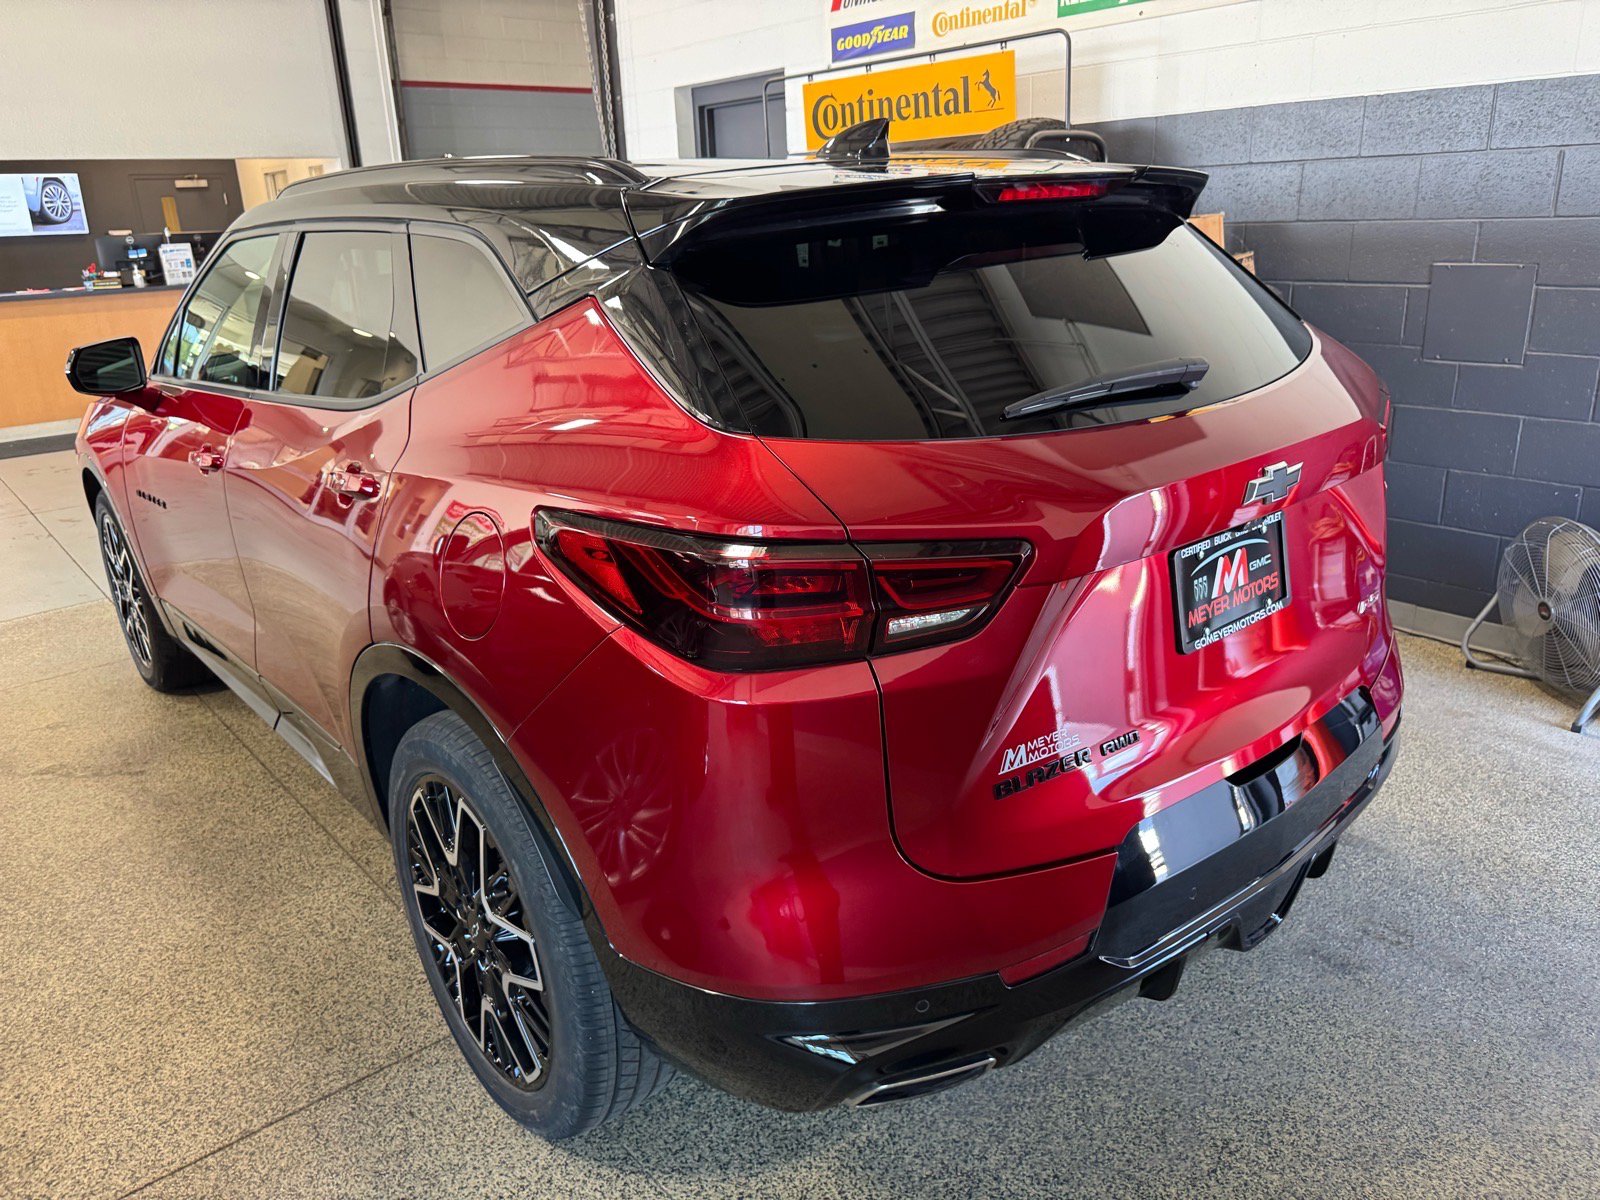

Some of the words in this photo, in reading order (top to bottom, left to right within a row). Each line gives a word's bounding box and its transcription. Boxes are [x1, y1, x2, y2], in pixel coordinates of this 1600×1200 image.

[932, 0, 1027, 37] Continental
[836, 25, 909, 51] GOODYEAR
[812, 76, 972, 141] Continental
[1181, 539, 1211, 558] CERTIFIED
[1214, 532, 1232, 546] BUICK
[1249, 553, 1272, 571] GMC
[1188, 594, 1230, 629] MEYER
[1232, 571, 1279, 607] MOTORS
[1194, 600, 1284, 650] GOMEYERMOTORS.COM
[1027, 728, 1068, 749] MEYER
[1028, 734, 1081, 762] MOTORS
[992, 747, 1092, 800] BLAZER
[1100, 729, 1141, 757] AWD
